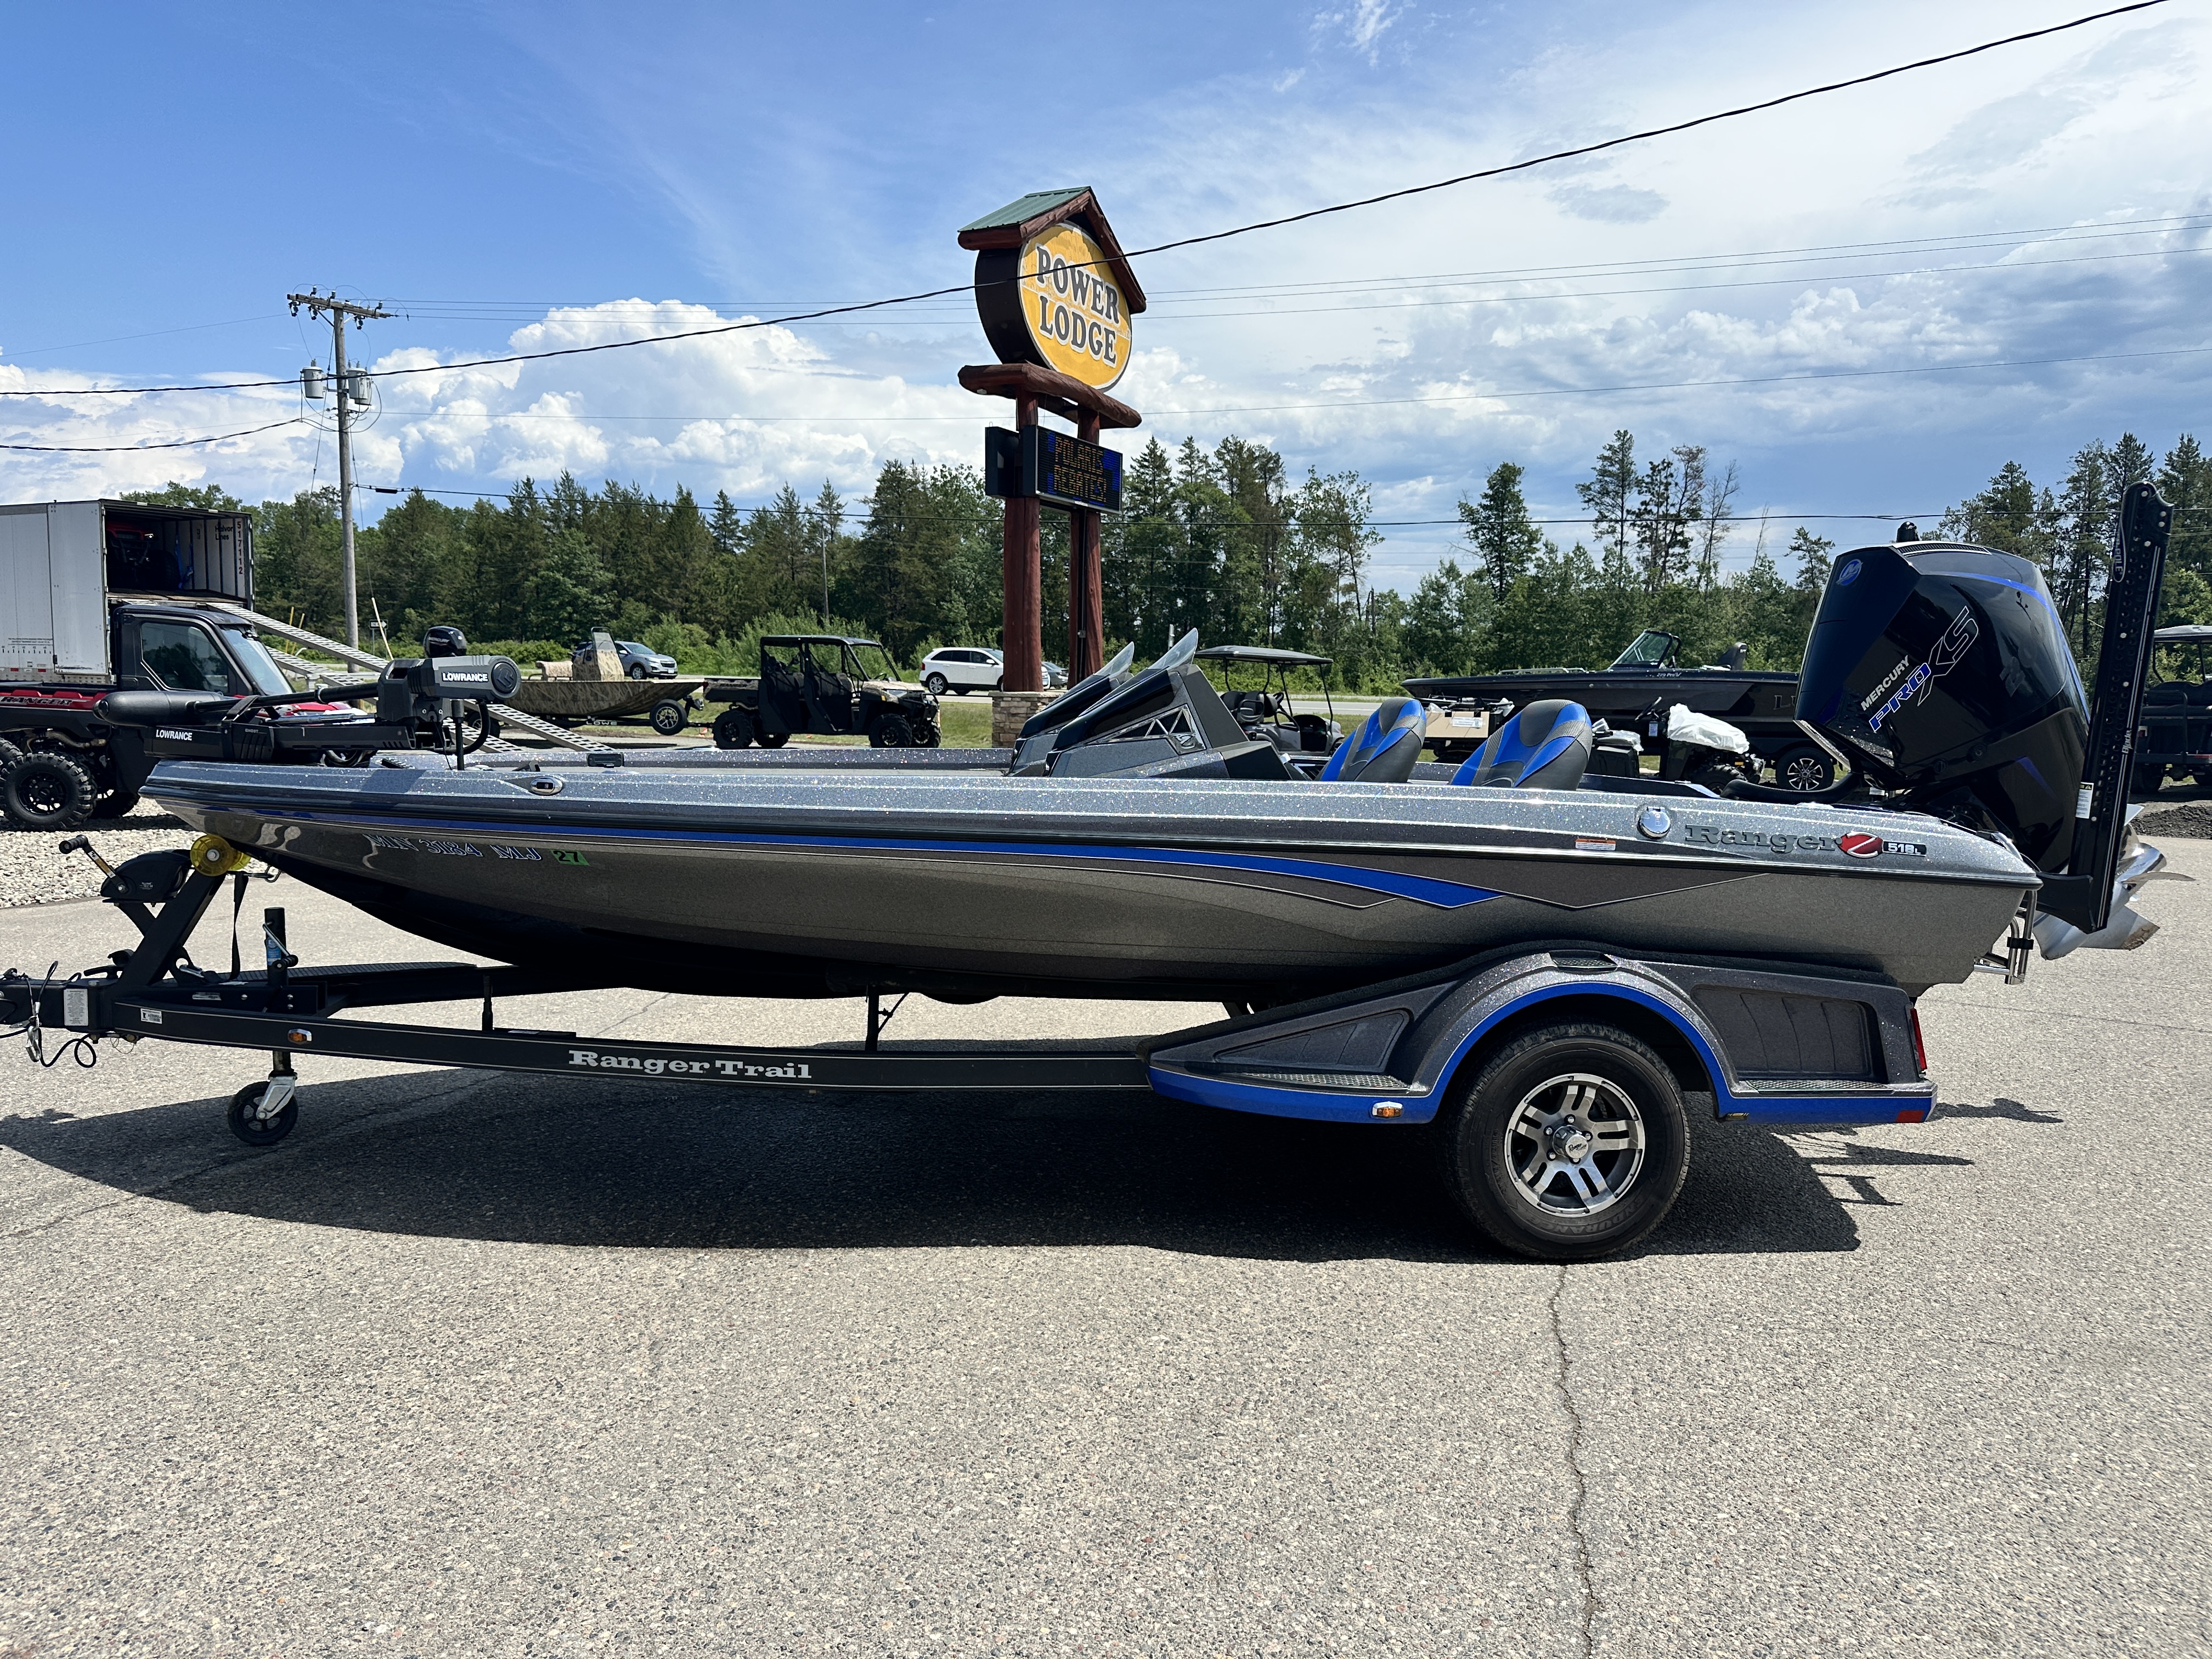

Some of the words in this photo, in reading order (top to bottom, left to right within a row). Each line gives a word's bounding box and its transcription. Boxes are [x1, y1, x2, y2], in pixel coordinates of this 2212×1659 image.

[1036, 246, 1119, 324] POWER
[1040, 295, 1116, 365] LODGE
[442, 672, 488, 682] LOWRANCE
[1860, 654, 1910, 711] MERCURY
[0, 696, 72, 706] RANGER
[156, 729, 193, 741] LOWRANCE
[419, 839, 484, 857] 3184
[489, 844, 543, 861] MJ
[1685, 823, 1843, 854] Ranger
[1888, 842, 1922, 854] 518L
[552, 850, 582, 863] 27
[568, 1049, 710, 1074] Ranger
[715, 1059, 812, 1079] Trail
[1526, 1195, 1644, 1234] ENDURANCE
